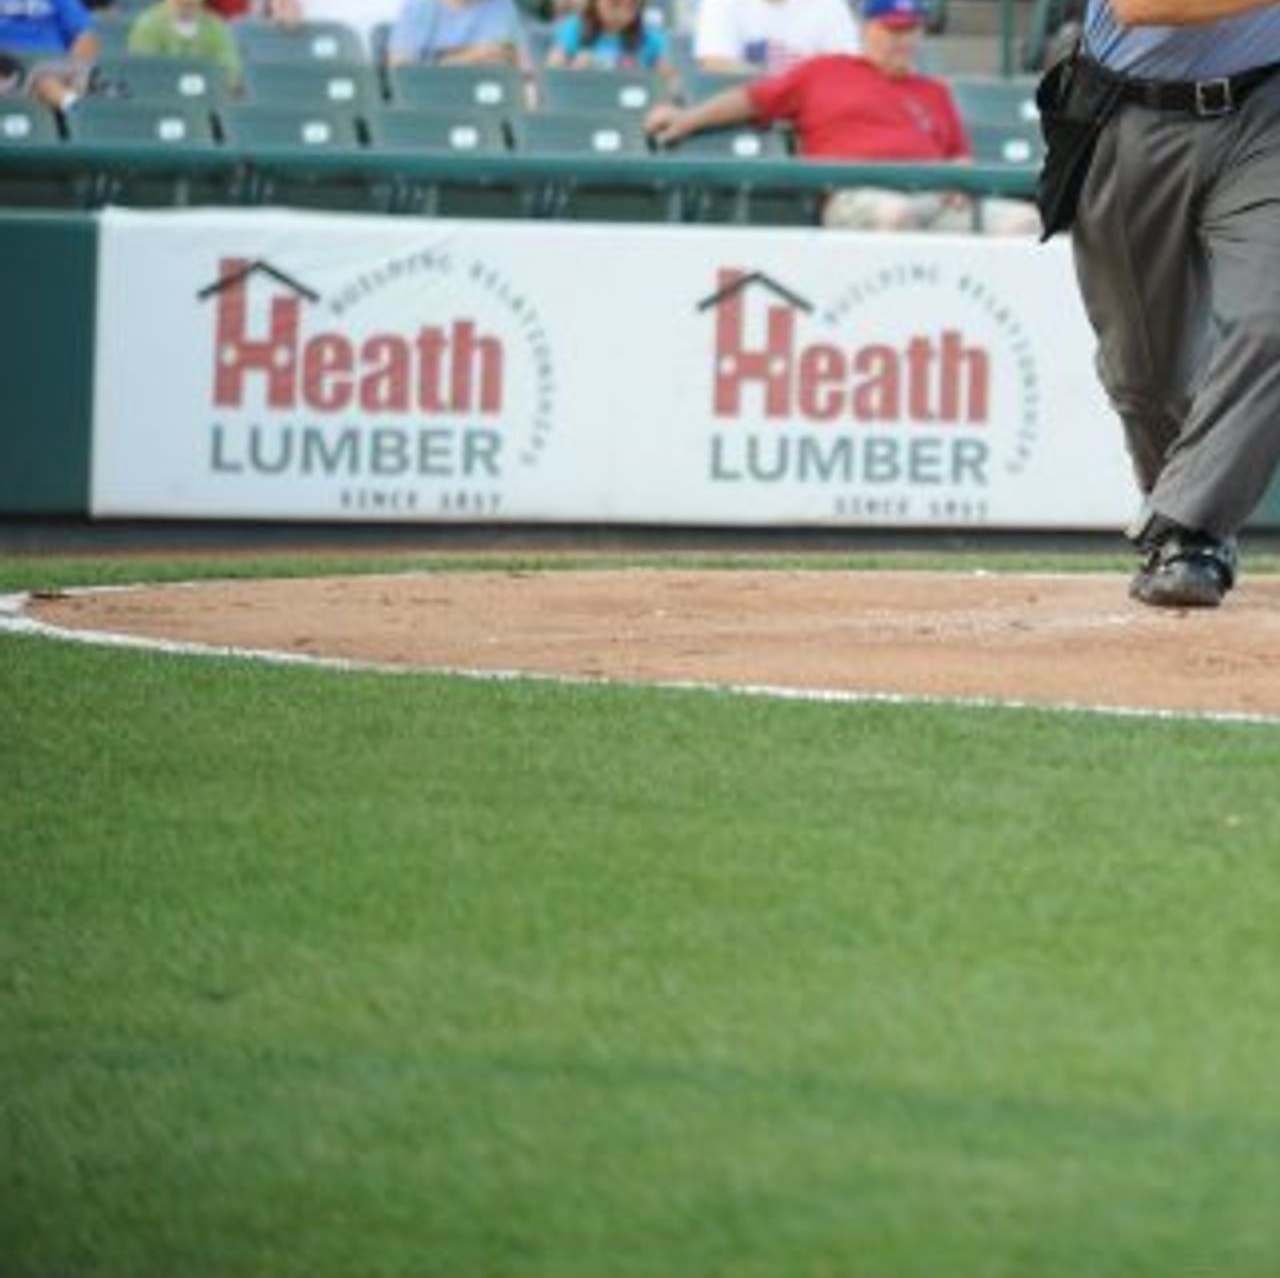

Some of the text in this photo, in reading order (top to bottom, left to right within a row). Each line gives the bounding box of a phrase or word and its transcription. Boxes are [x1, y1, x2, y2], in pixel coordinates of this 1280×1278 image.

[212, 257, 504, 413] Heath
[713, 268, 989, 423] Heath
[210, 425, 503, 476] LUMBER
[709, 435, 990, 485] LUMBER
